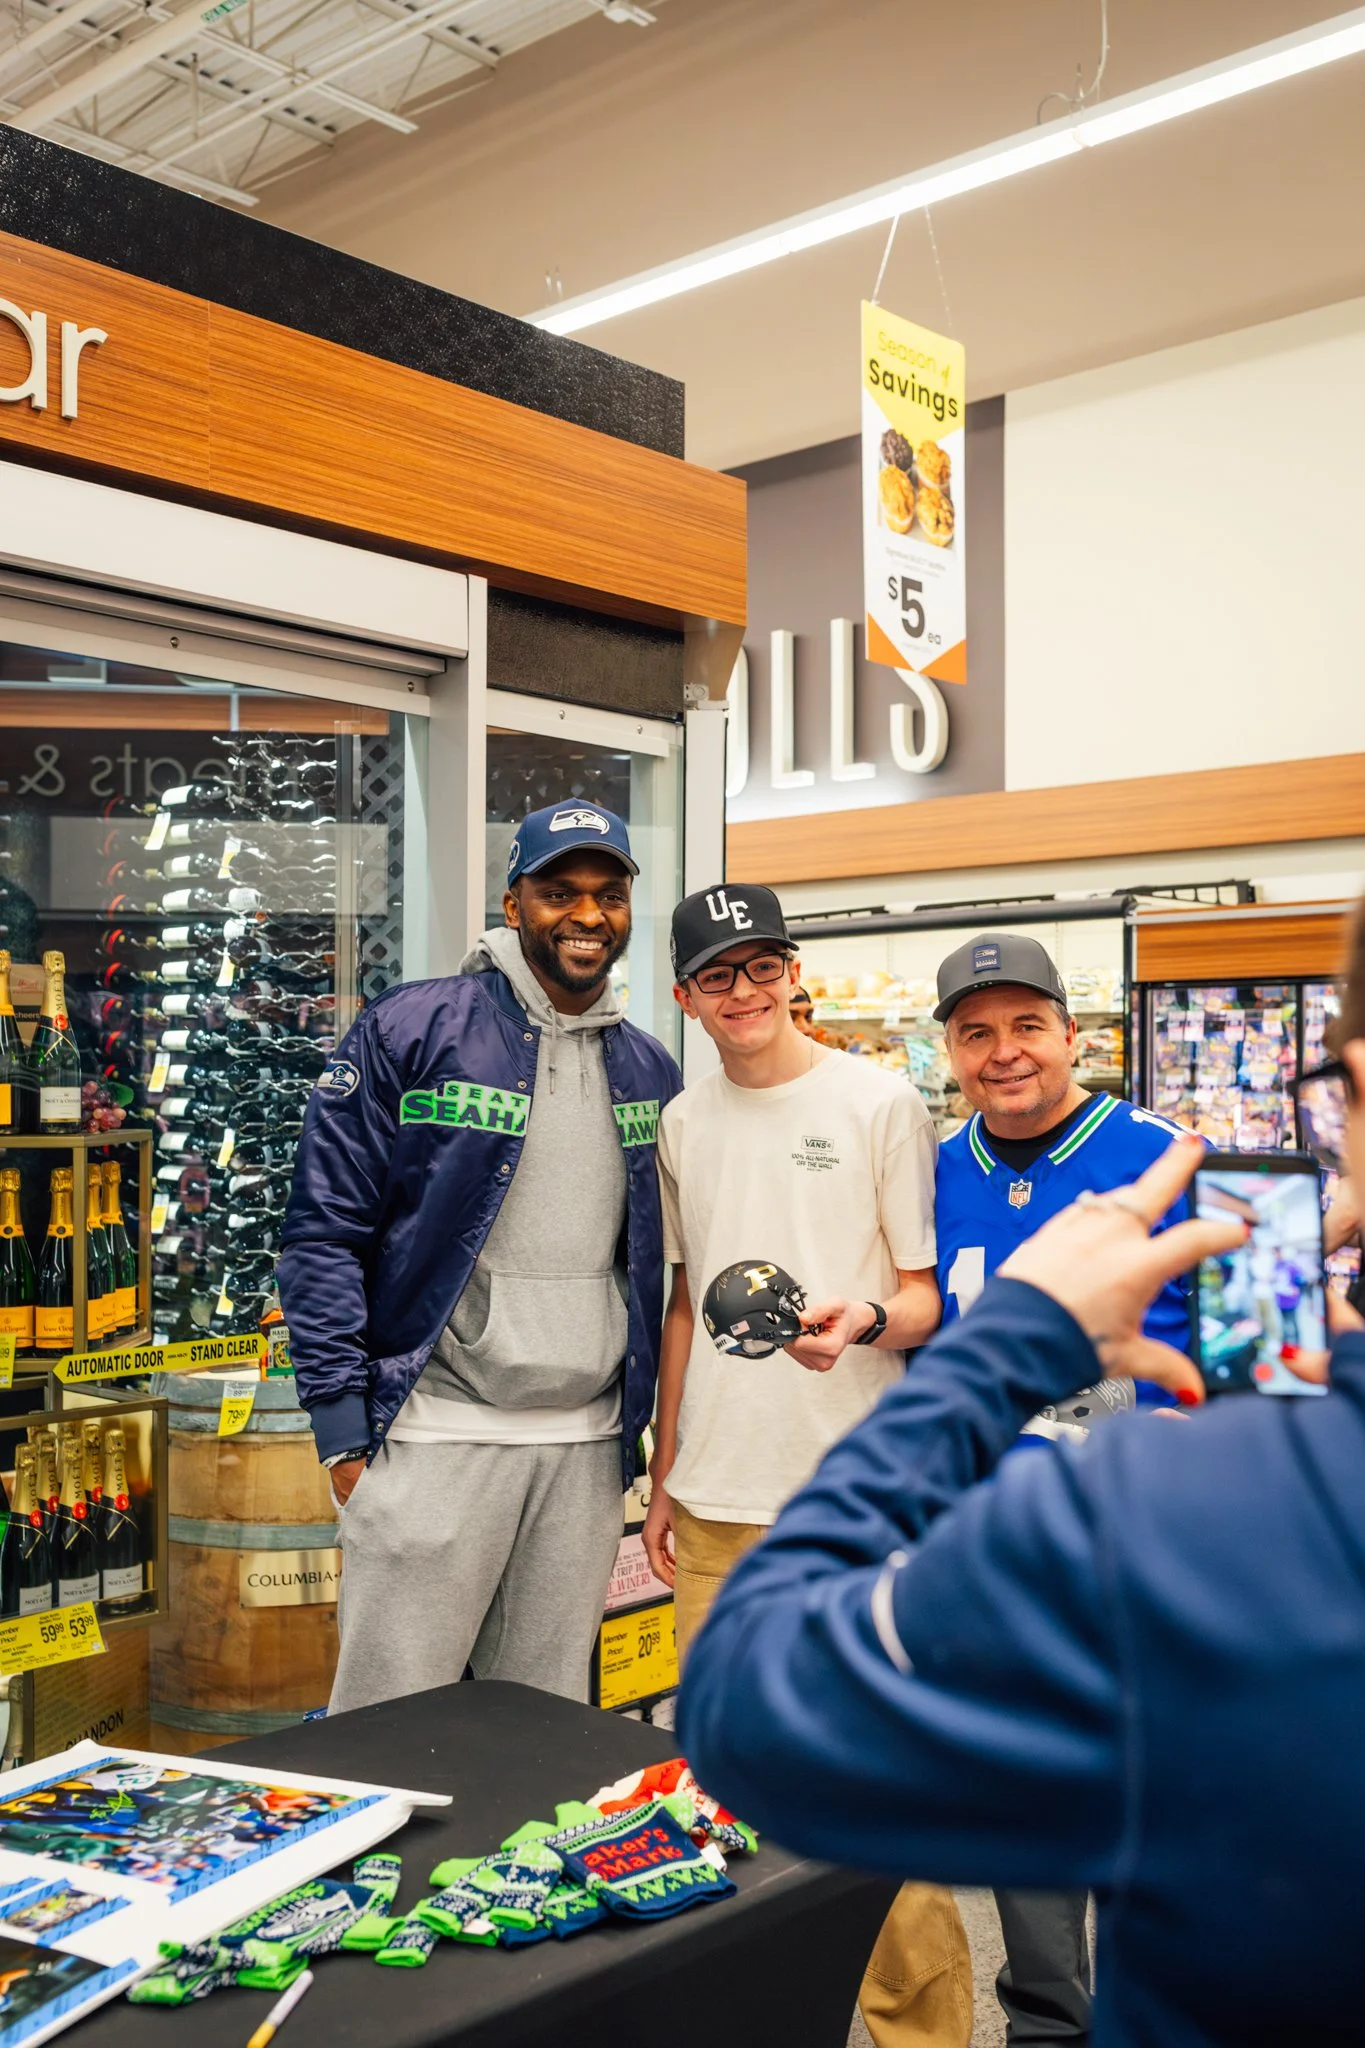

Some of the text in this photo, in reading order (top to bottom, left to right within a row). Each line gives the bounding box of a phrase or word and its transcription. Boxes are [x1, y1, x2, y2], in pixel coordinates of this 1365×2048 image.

[878, 331, 936, 373] Season
[869, 358, 958, 422] Savings
[705, 890, 753, 931] UE
[805, 1138, 827, 1149] VANS
[1012, 1192, 1027, 1202] NFL
[744, 1264, 778, 1297] P
[66, 1353, 131, 1378] AUTOMATIC
[134, 1350, 165, 1370] DOOR
[191, 1343, 224, 1363] STAND
[227, 1339, 259, 1358] CLEAR
[604, 1632, 628, 1645] Member
